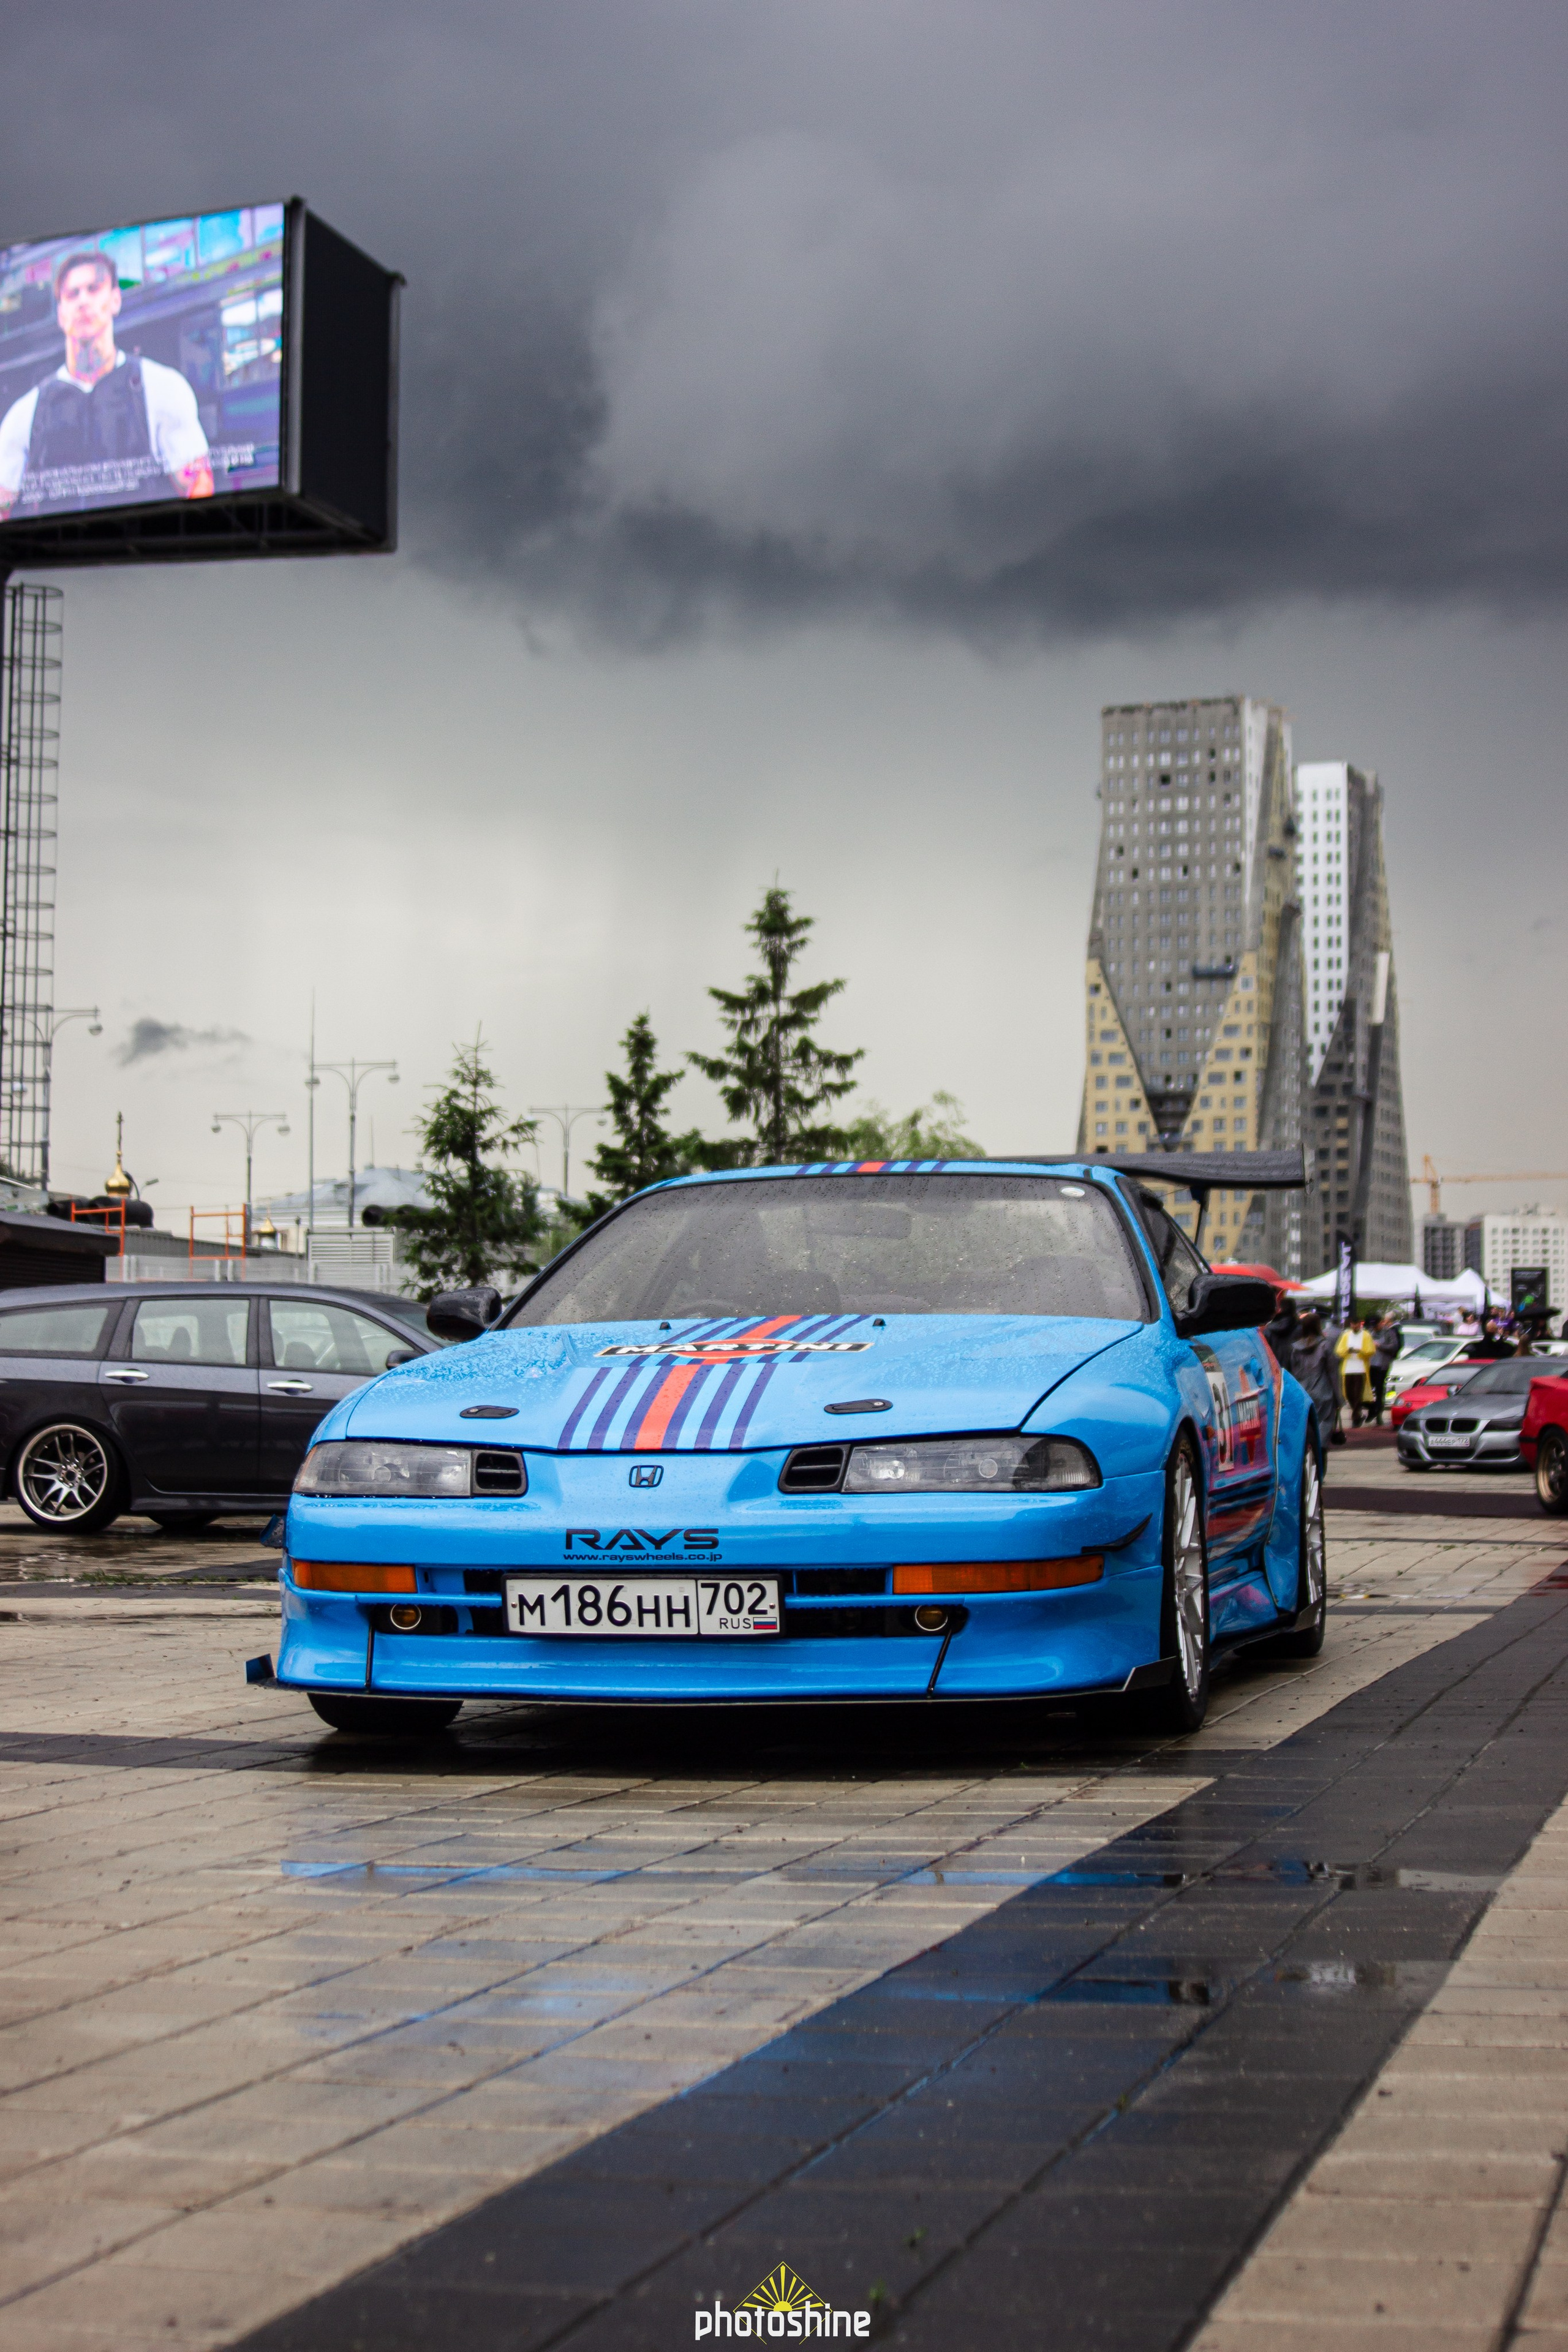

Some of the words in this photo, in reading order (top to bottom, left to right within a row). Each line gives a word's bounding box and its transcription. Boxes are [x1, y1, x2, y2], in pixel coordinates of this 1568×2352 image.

[615, 1343, 856, 1354] MARTINI
[1212, 1382, 1234, 1464] 31
[565, 1528, 720, 1550] RAYS
[563, 1552, 723, 1562] www.rayswheels.co.jp
[700, 1582, 768, 1616] 702
[719, 1618, 752, 1629] RUS
